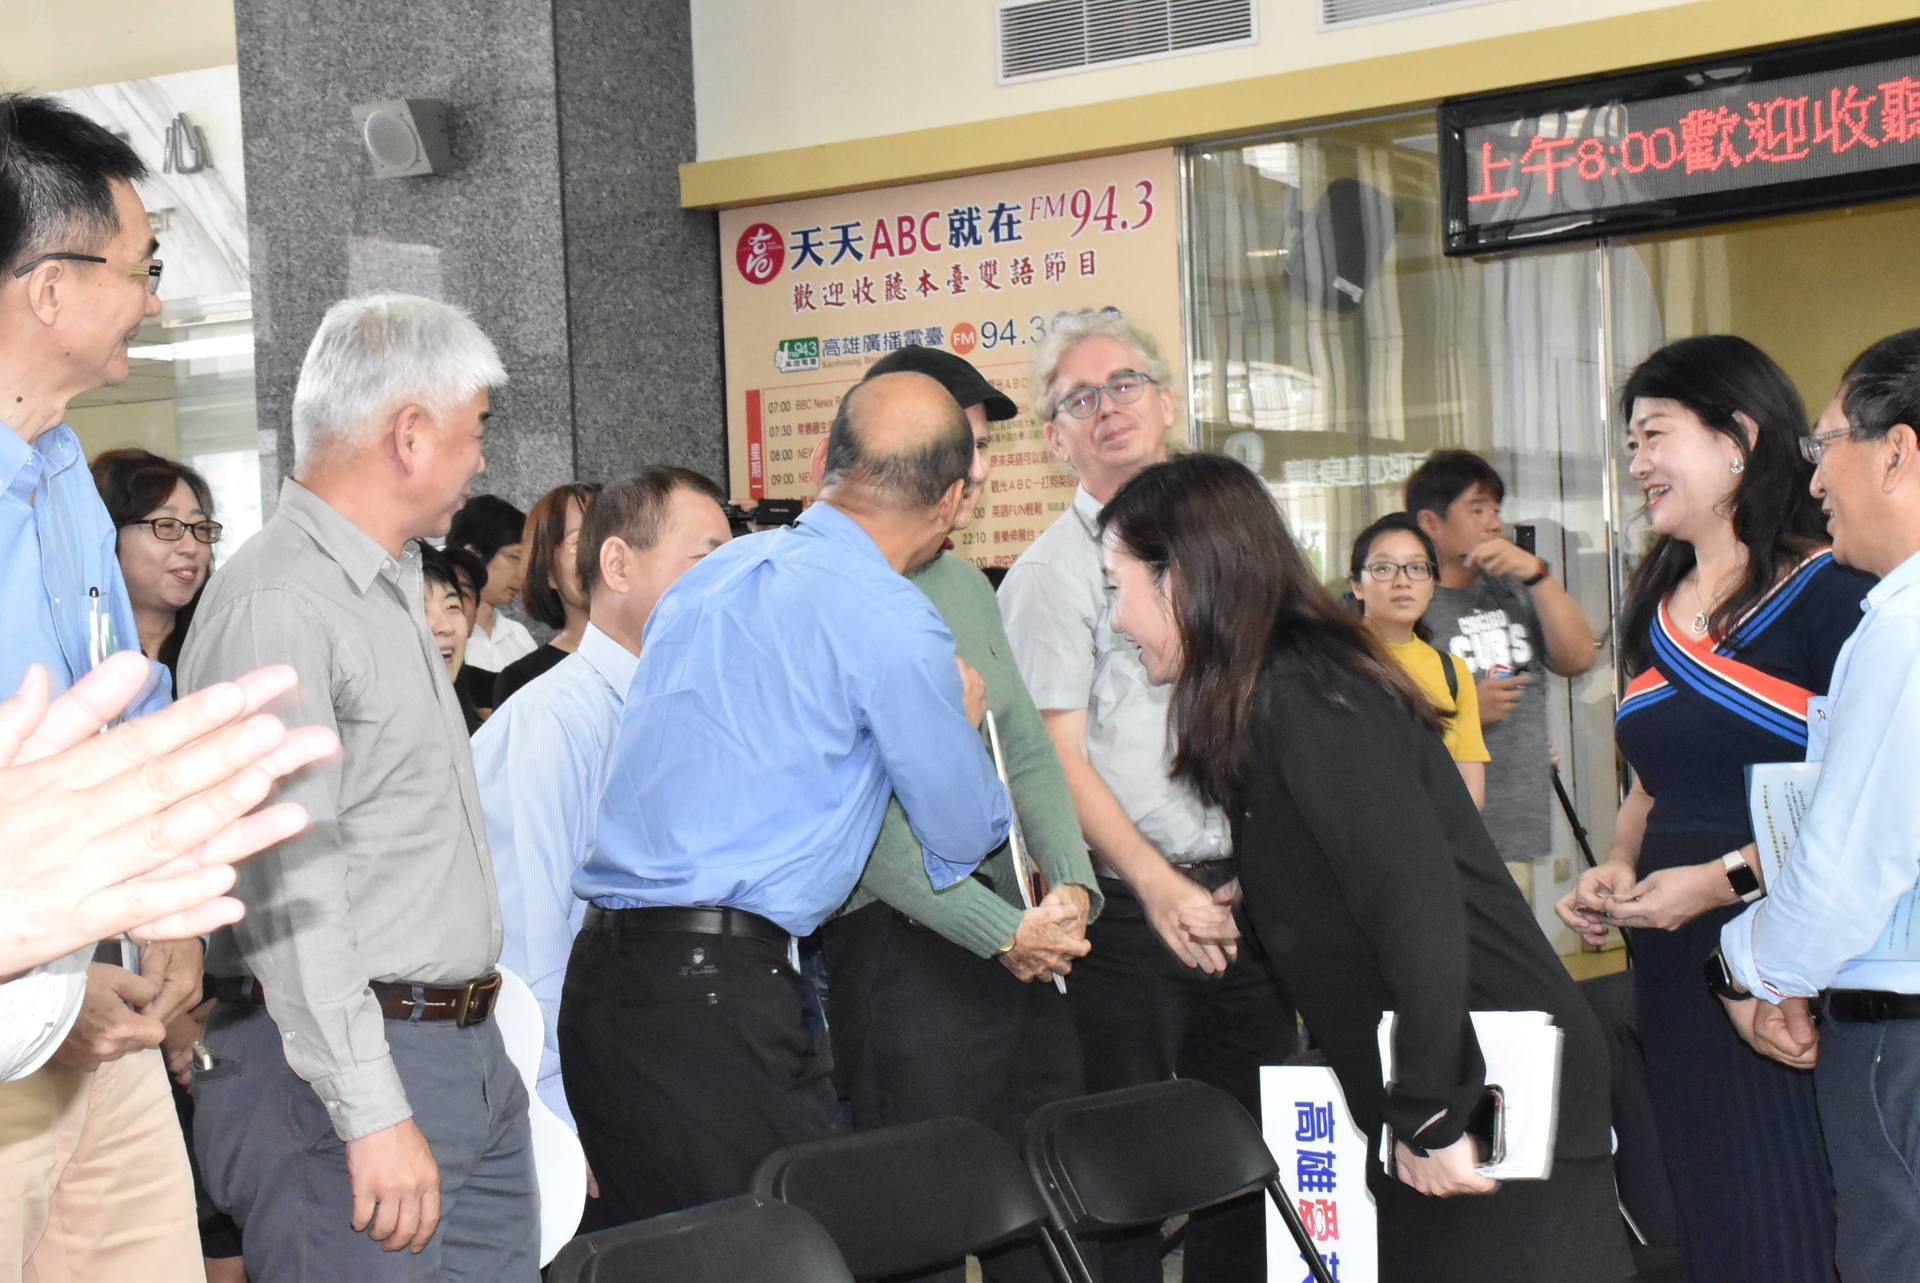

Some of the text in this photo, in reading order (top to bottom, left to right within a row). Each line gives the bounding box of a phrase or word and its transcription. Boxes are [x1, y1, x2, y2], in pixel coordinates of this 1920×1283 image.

[1030, 193, 1066, 221] FM
[1070, 179, 1153, 238] 94.3
[793, 250, 1096, 312] 歡迎收聽本臺雙語節目
[952, 331, 975, 345] FM
[768, 401, 792, 413] 07:00
[796, 401, 812, 410] BBC
[814, 398, 834, 409] News
[769, 425, 792, 438] 07:30
[770, 449, 793, 461] 08:00
[771, 473, 794, 486] 09:00
[962, 532, 986, 544] 22:10
